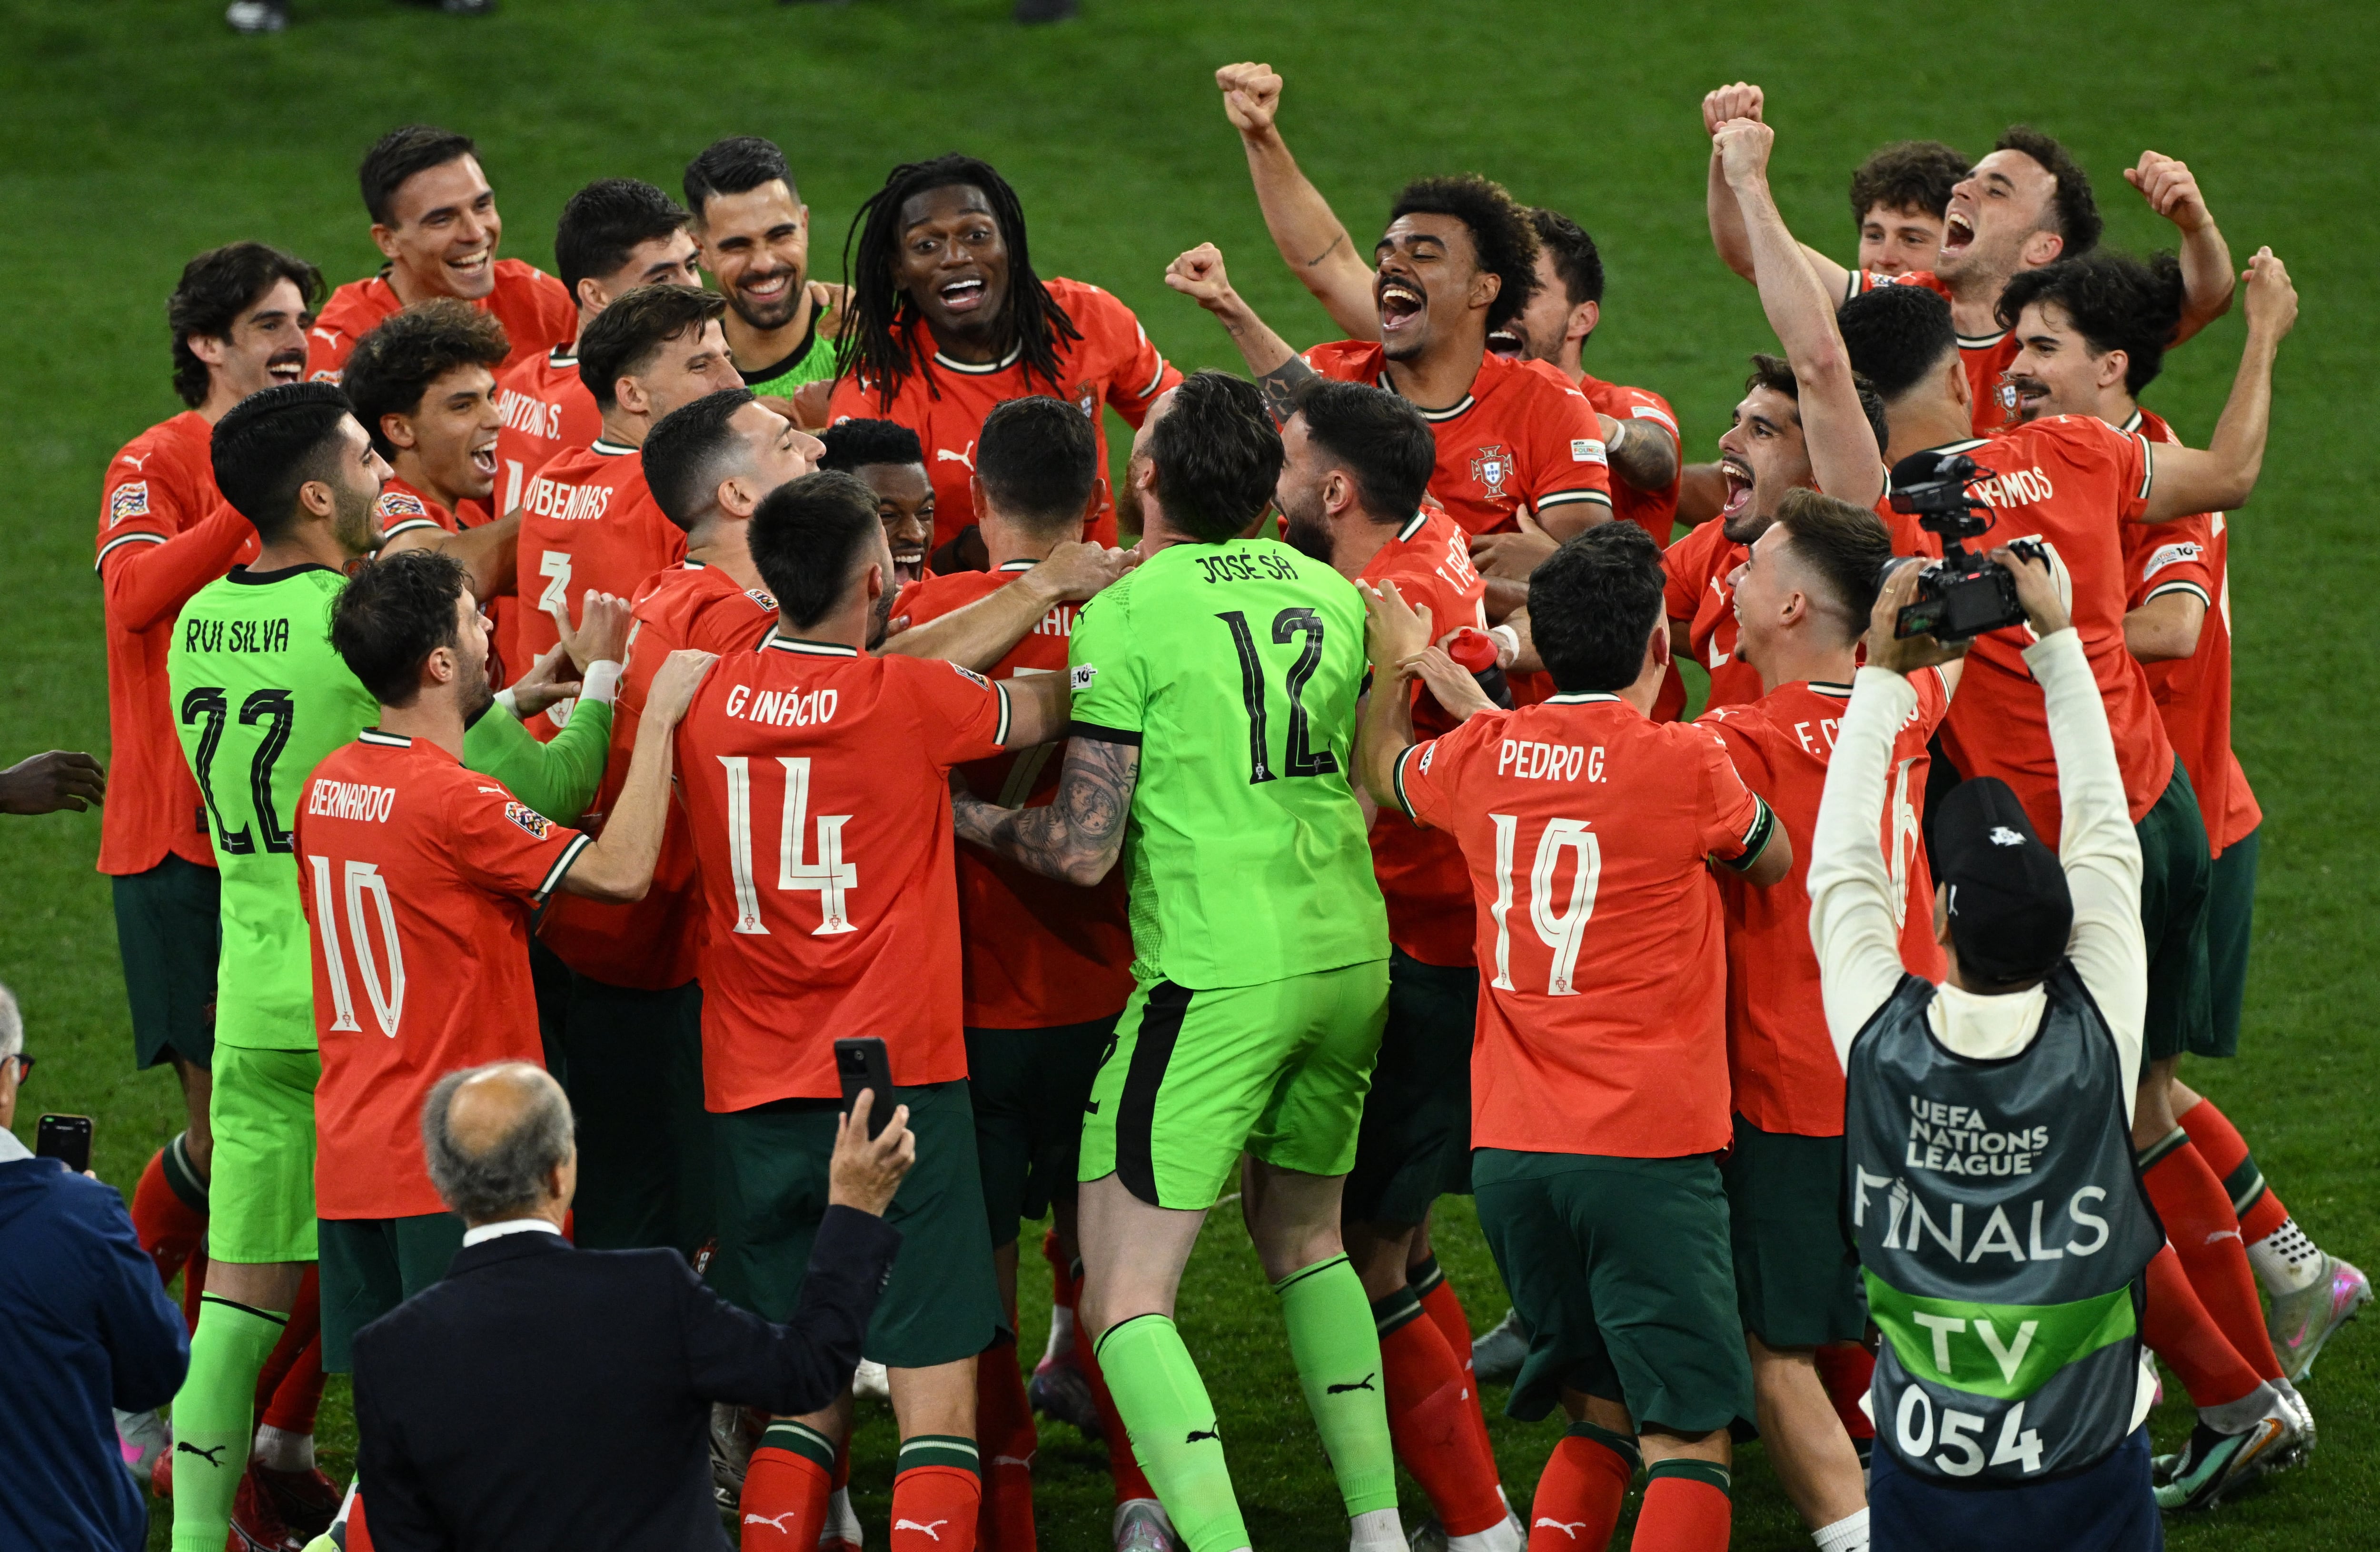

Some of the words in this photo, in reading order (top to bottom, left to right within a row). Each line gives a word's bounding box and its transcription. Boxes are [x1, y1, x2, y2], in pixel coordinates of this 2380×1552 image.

[547, 404, 561, 440] S.
[1971, 466, 2053, 509] RAMOS
[1195, 547, 1266, 583] JOSÉ
[1258, 549, 1299, 580] SÁ
[186, 618, 222, 652] RUI
[228, 618, 289, 653] SILVA
[1214, 607, 1339, 785] 12
[181, 687, 294, 855] 22
[1498, 739, 1585, 782] PEDRO
[1588, 746, 1607, 782] G.
[308, 779, 396, 823] BERNARDO
[716, 755, 859, 935] 14
[1488, 813, 1601, 996] 19
[307, 855, 406, 1038] 10
[1910, 1095, 1987, 1131] UEFA
[1909, 1117, 2049, 1154] NATIONS
[1906, 1141, 2032, 1176] LEAGUE
[1854, 1163, 2110, 1263] FINALS
[1913, 1310, 2039, 1384] TV
[1896, 1383, 2043, 1476] 054
